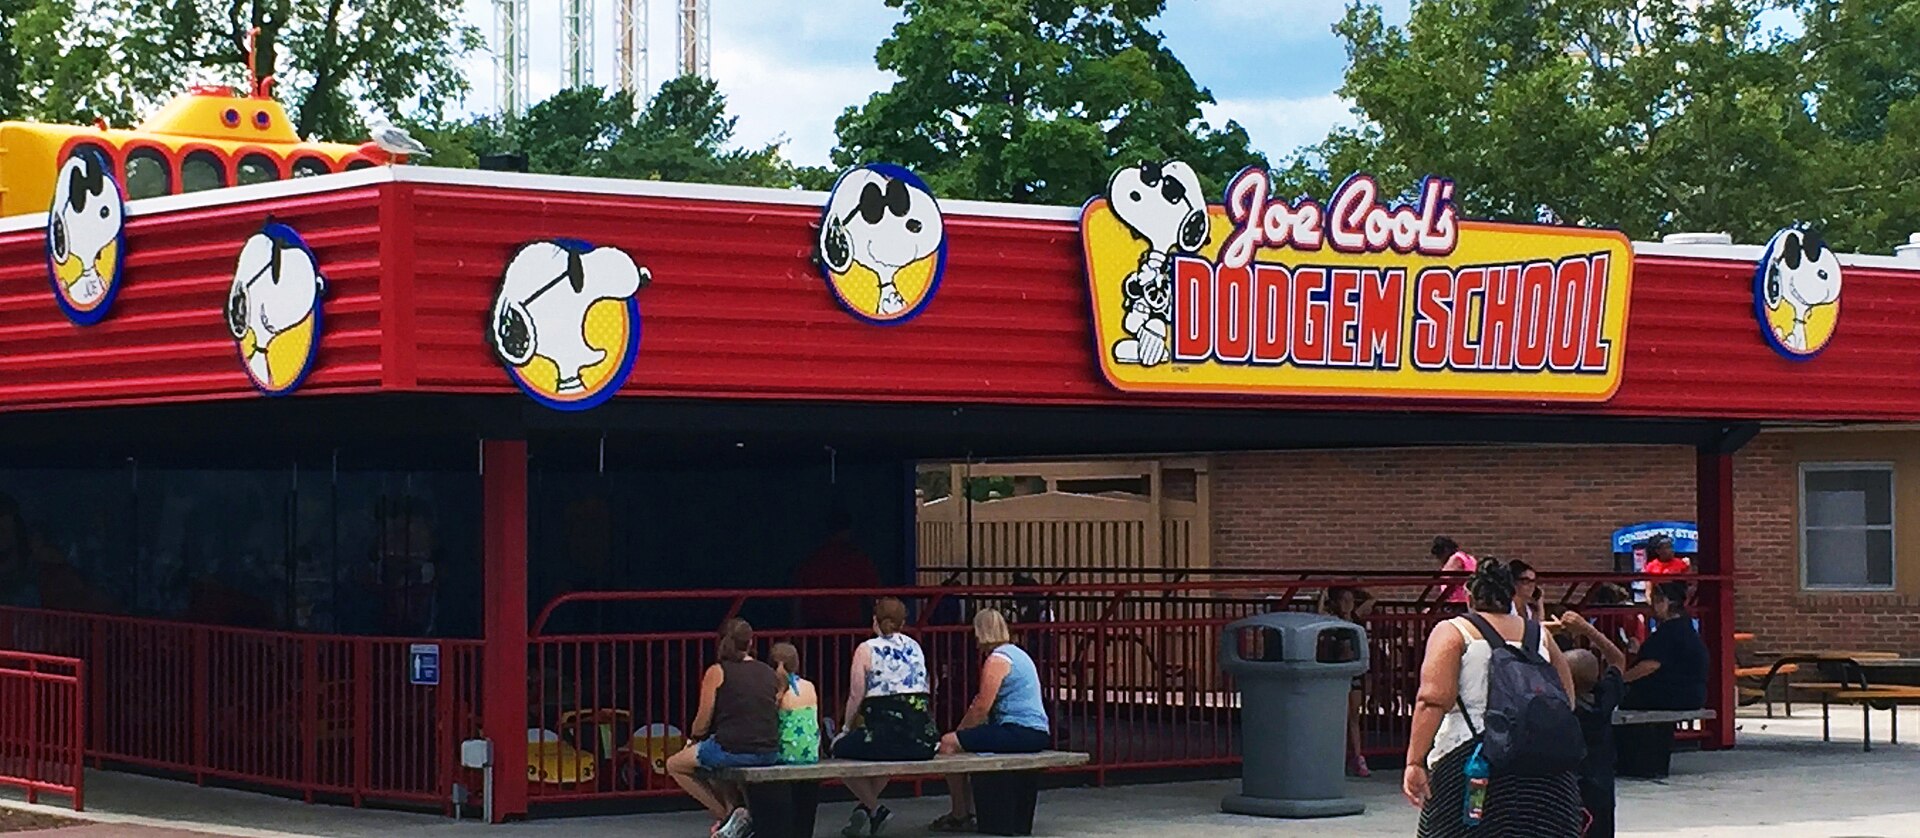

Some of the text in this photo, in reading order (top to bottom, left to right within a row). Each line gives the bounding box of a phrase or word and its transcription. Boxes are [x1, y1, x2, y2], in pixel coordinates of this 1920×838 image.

[1224, 170, 1457, 268] Joe Cool's
[1173, 252, 1612, 373] DODGEM SCHOOL
